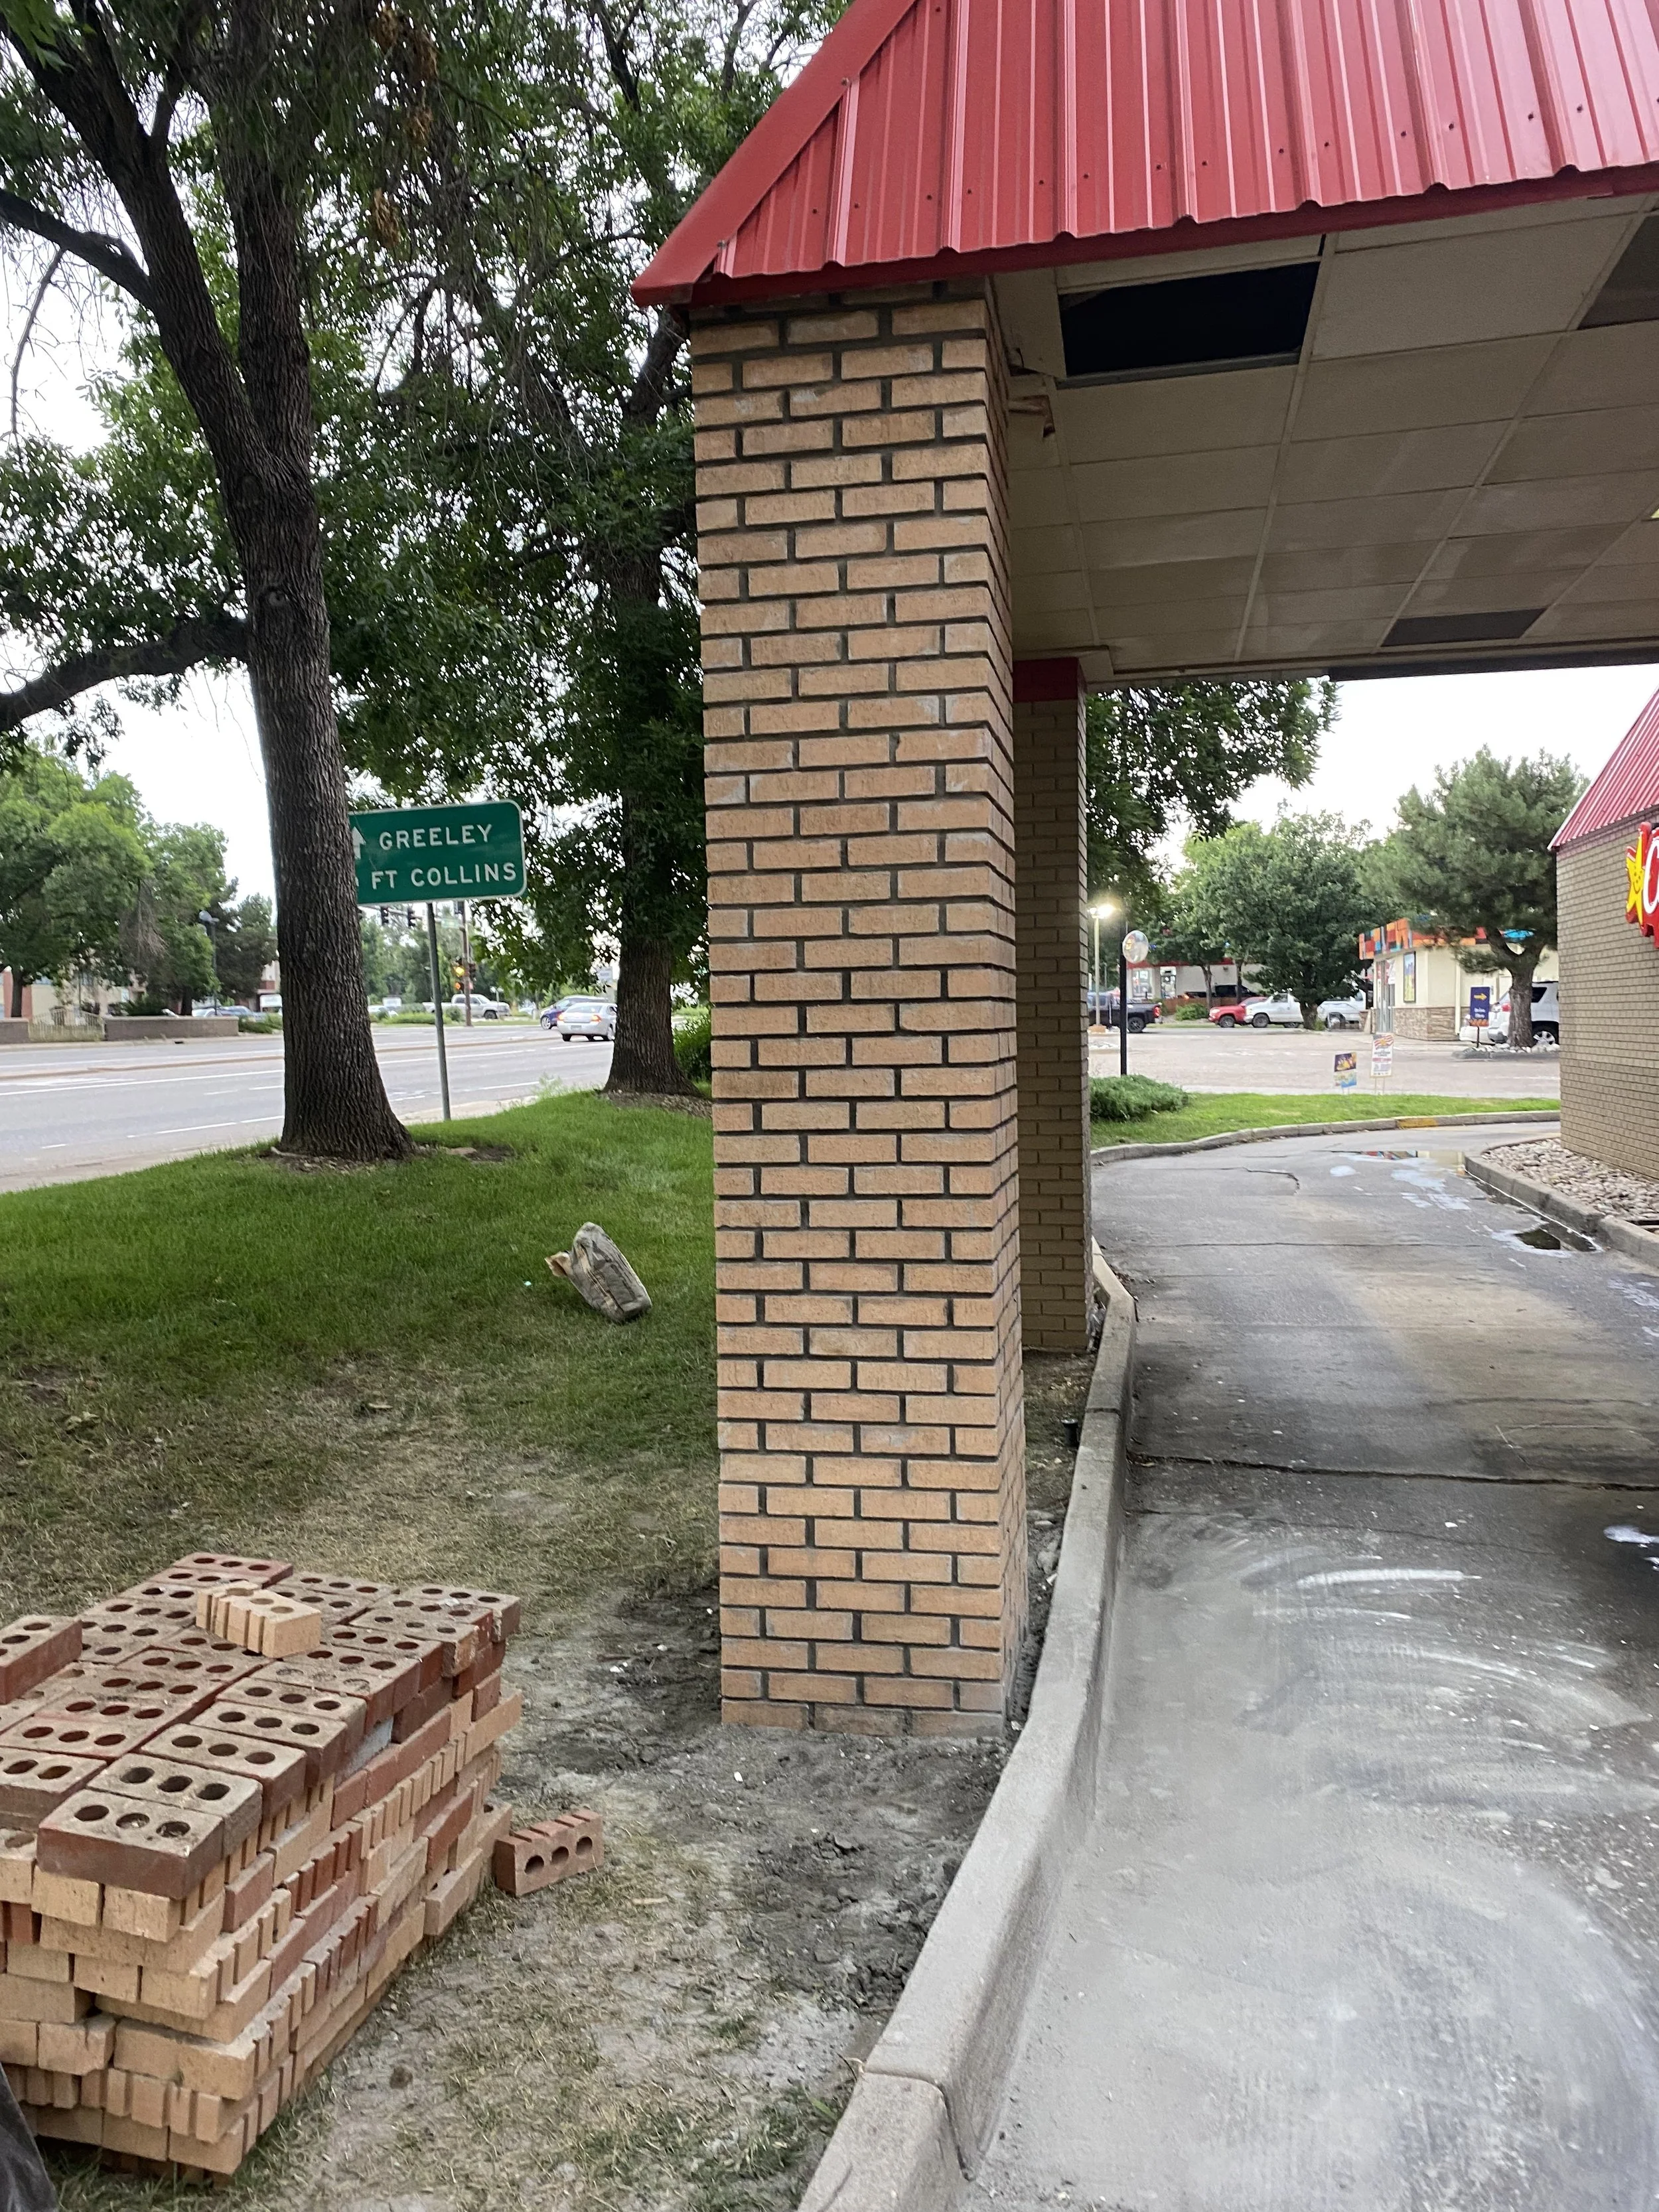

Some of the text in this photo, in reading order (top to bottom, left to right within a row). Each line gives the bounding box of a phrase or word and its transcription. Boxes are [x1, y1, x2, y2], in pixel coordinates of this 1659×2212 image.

[379, 824, 492, 850] GREELEY
[371, 863, 516, 890] FT COLLINS
